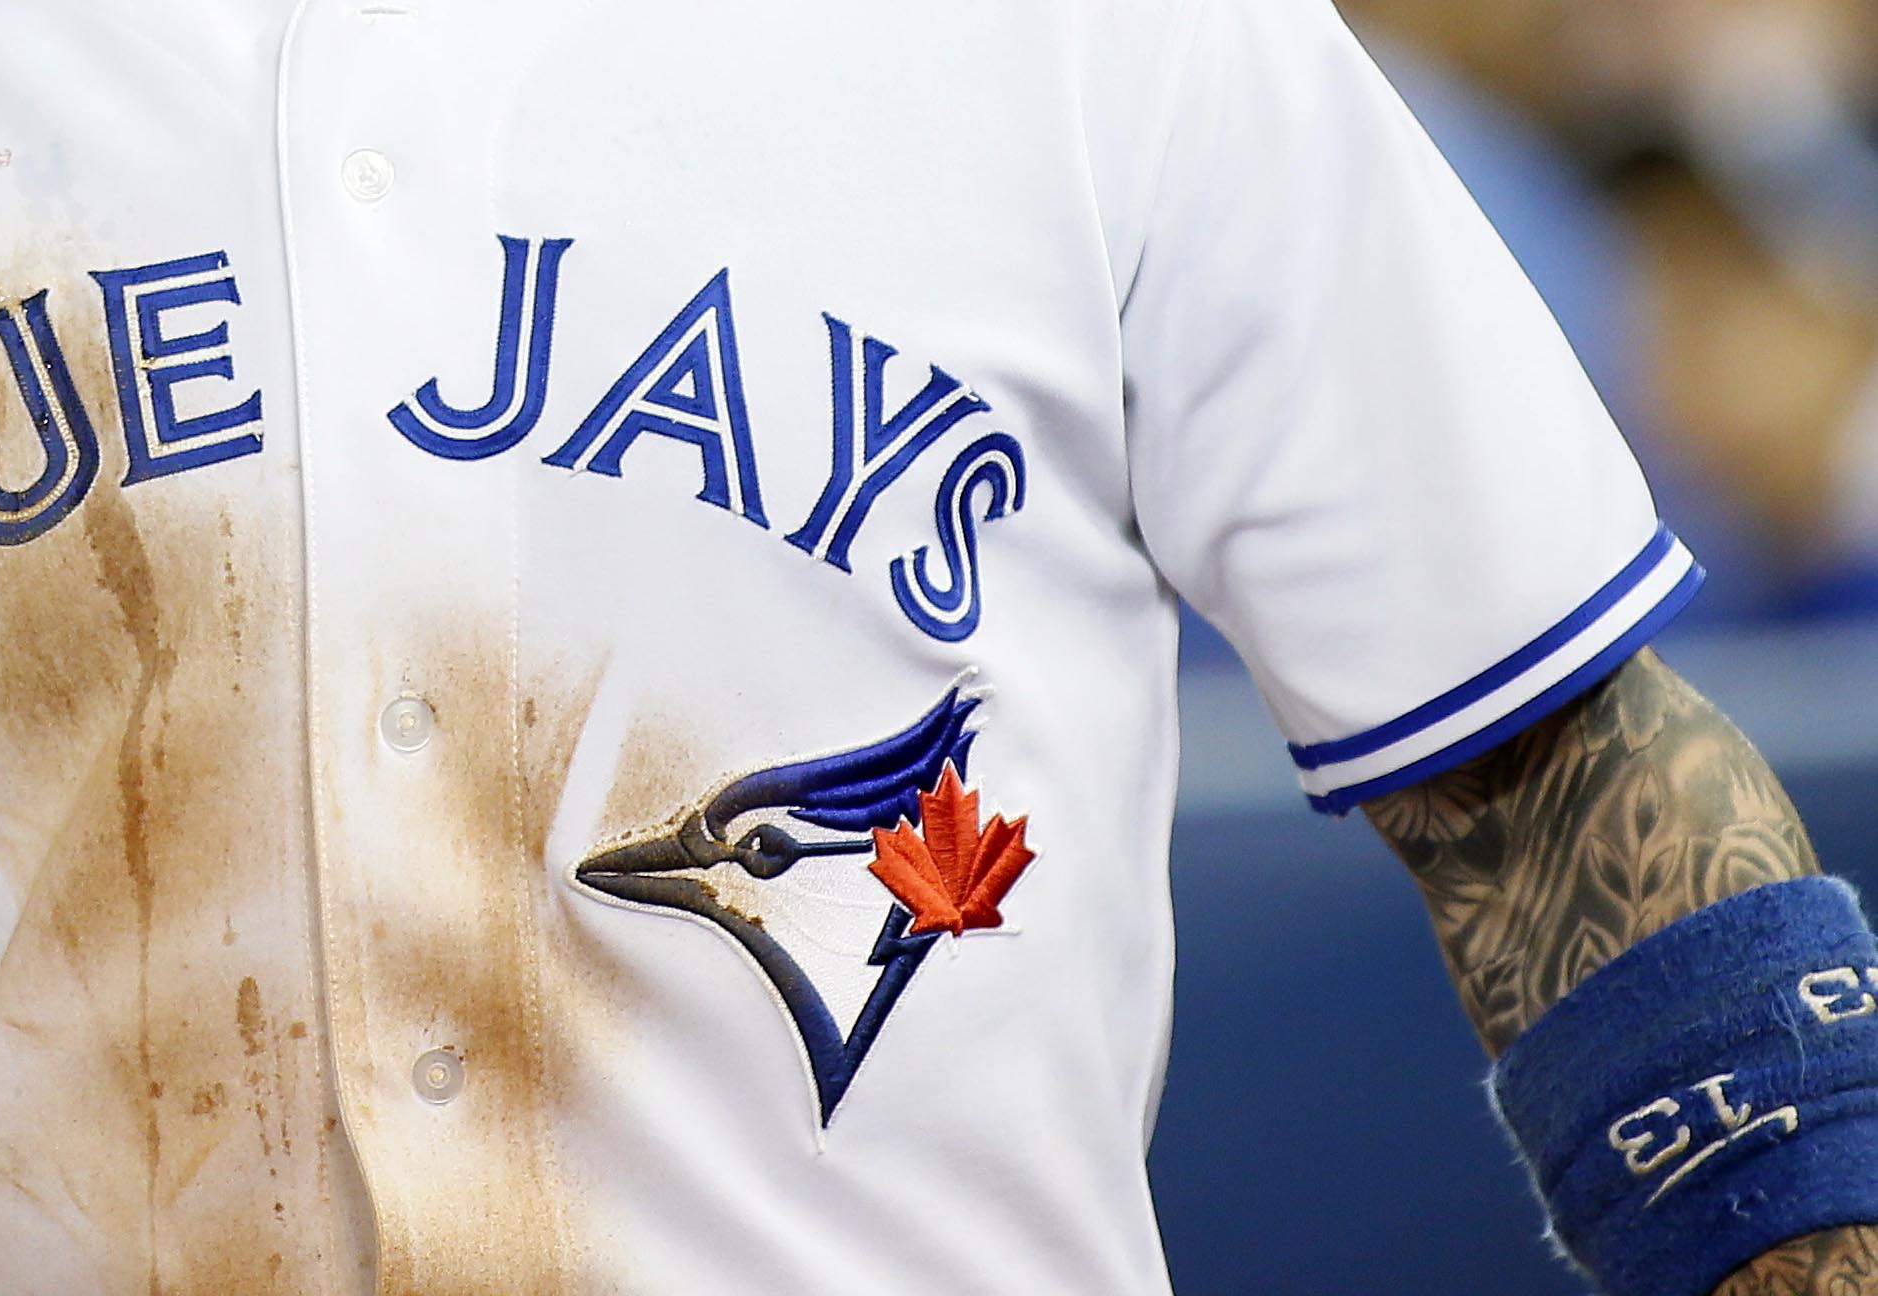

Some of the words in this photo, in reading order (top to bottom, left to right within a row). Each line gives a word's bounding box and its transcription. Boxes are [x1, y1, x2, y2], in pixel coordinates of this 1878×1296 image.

[387, 233, 1026, 642] JAYS
[1797, 965, 1878, 1025] 3
[1607, 1072, 1752, 1176] 13
